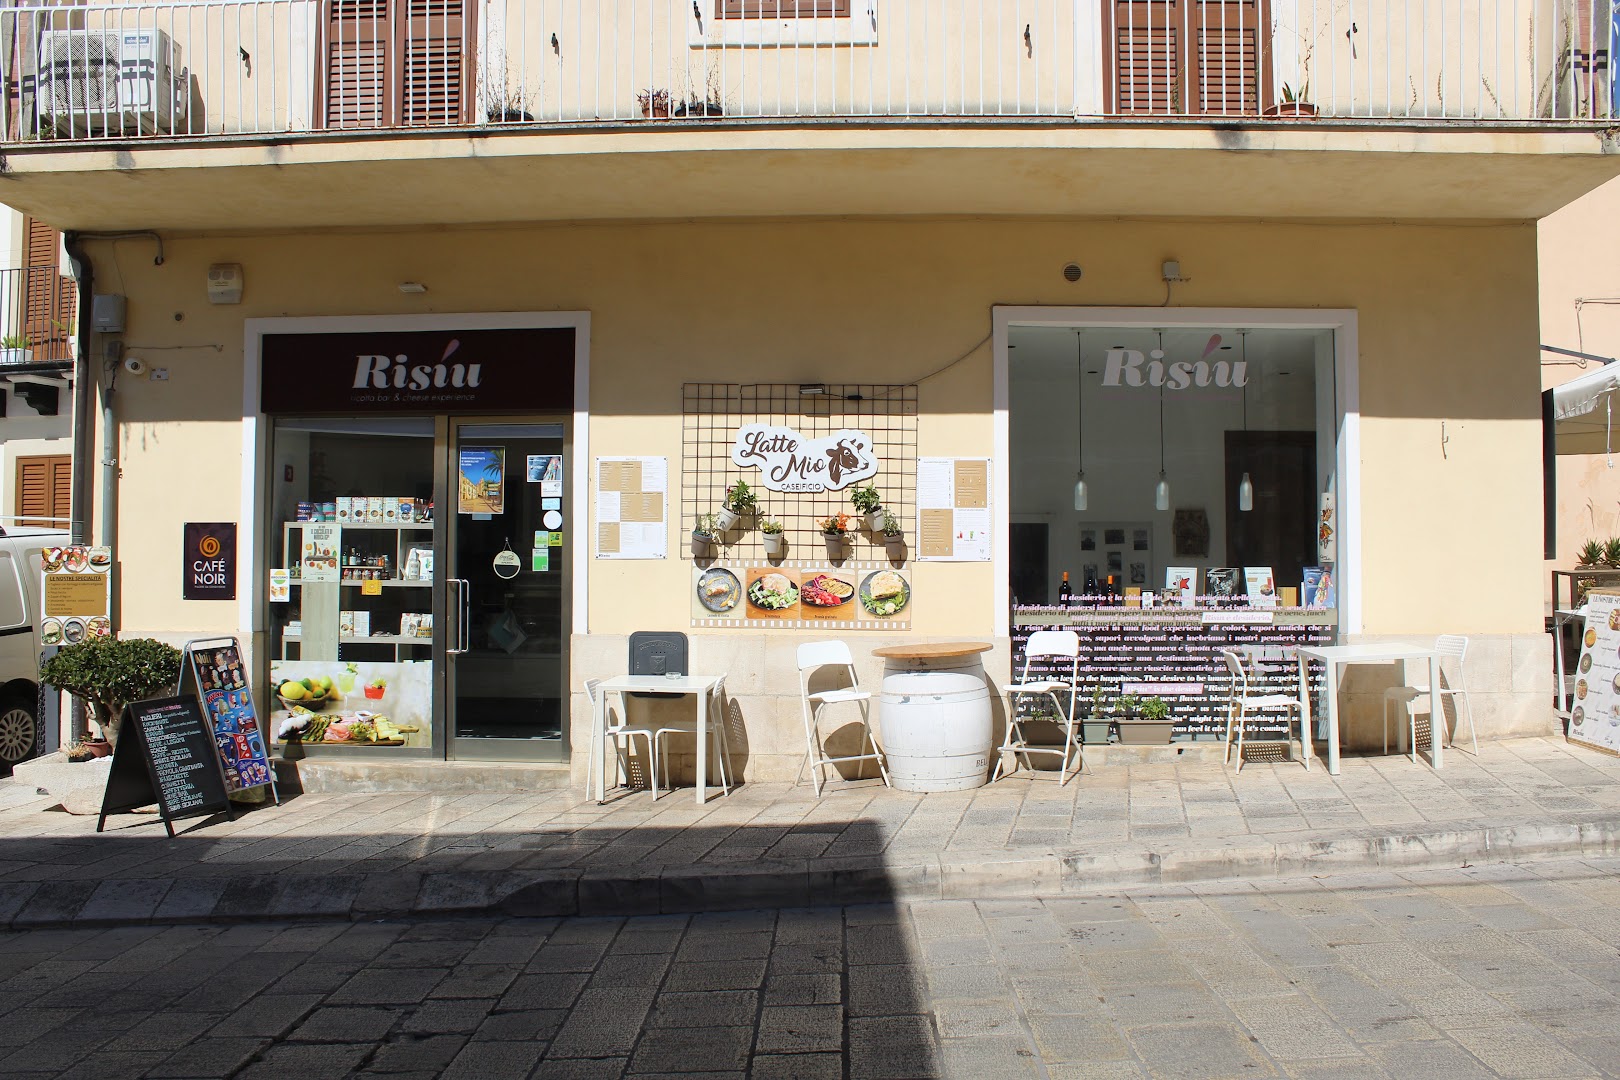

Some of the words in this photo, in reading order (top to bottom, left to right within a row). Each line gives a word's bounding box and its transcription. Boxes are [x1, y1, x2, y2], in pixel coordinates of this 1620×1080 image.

[394, 393, 400, 401] &
[402, 393, 430, 401] cheese
[432, 393, 475, 402] experience
[740, 431, 799, 462] Latte
[771, 454, 826, 482] Mio
[194, 558, 226, 572] CAFÉ
[195, 574, 226, 584] NOIR
[1098, 604, 1141, 612] immergere
[1189, 715, 1212, 723] might
[1260, 725, 1289, 733] coming.
